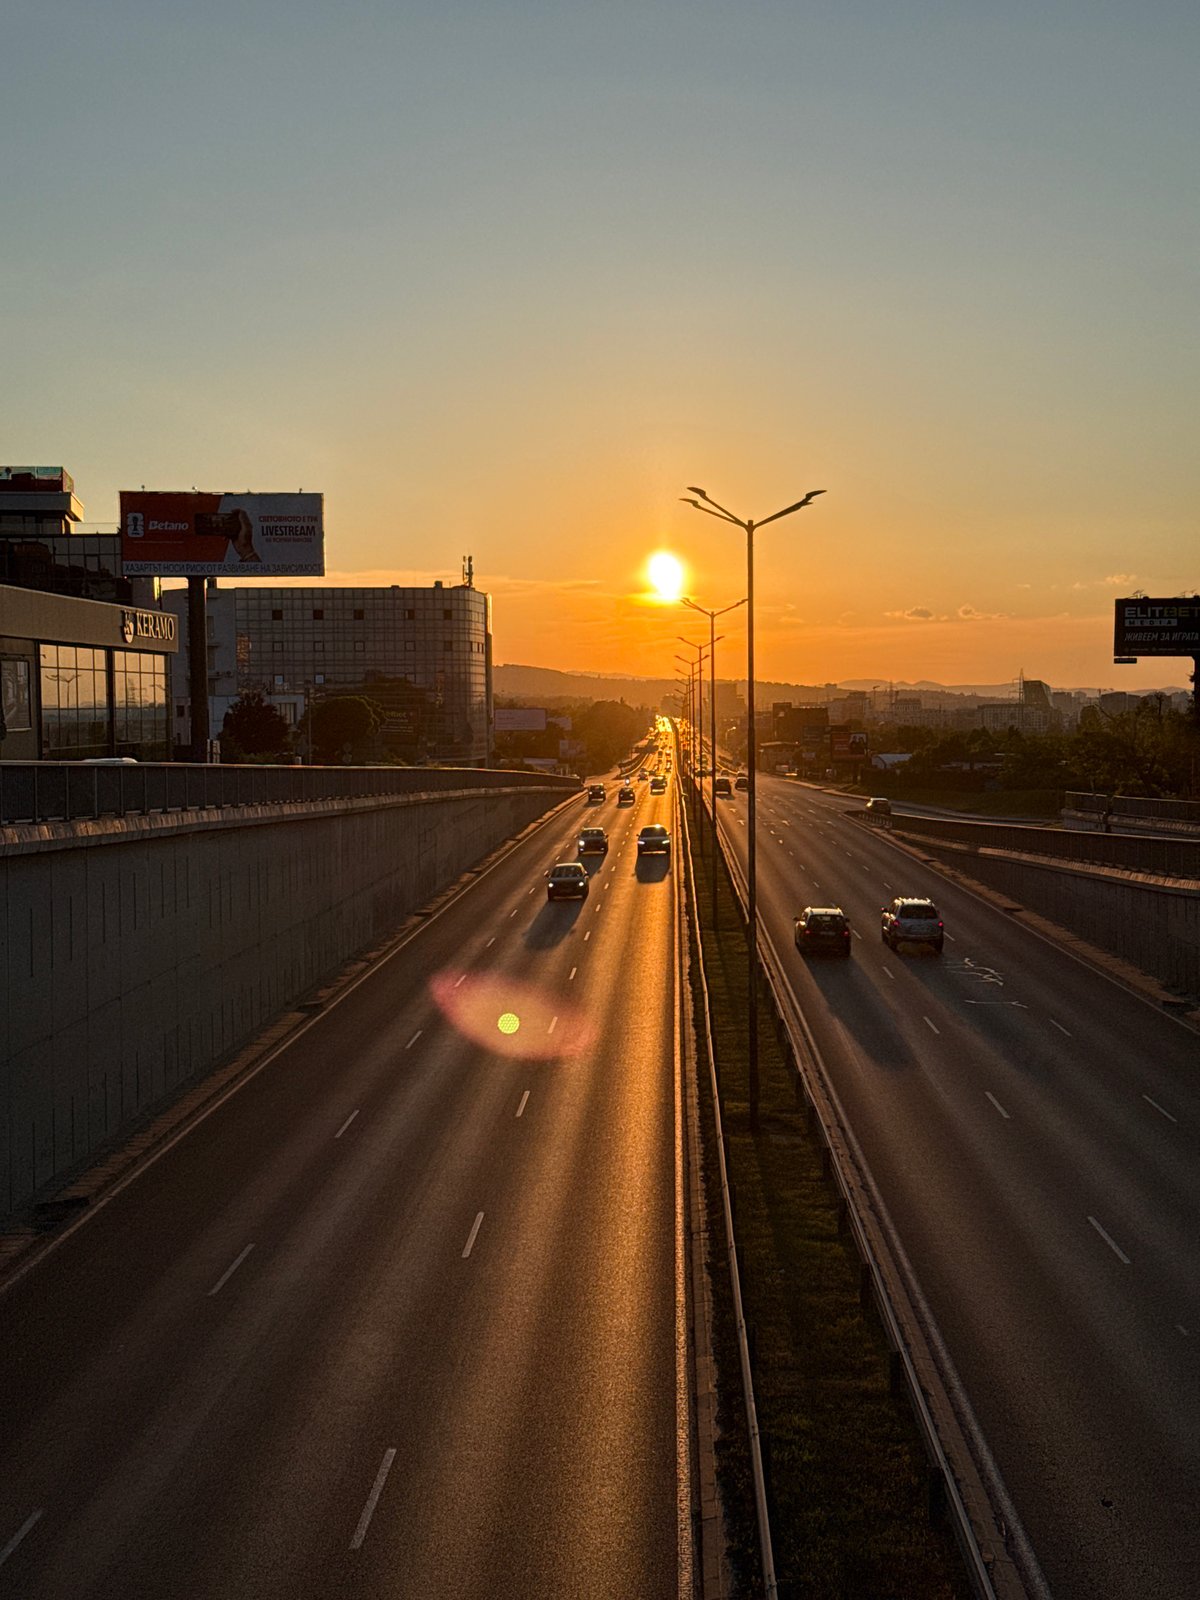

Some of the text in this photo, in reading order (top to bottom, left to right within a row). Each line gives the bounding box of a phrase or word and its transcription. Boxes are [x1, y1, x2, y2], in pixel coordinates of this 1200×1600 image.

[148, 520, 189, 531] Betano
[261, 525, 316, 537] LIVESTREAM
[125, 563, 162, 573] ХАЗАРТЪТ
[163, 563, 185, 573] НОСИ
[186, 563, 206, 573] РИСК
[206, 563, 217, 573] ОТ
[136, 612, 175, 641] KERAMO
[1160, 632, 1170, 641] ЗА
